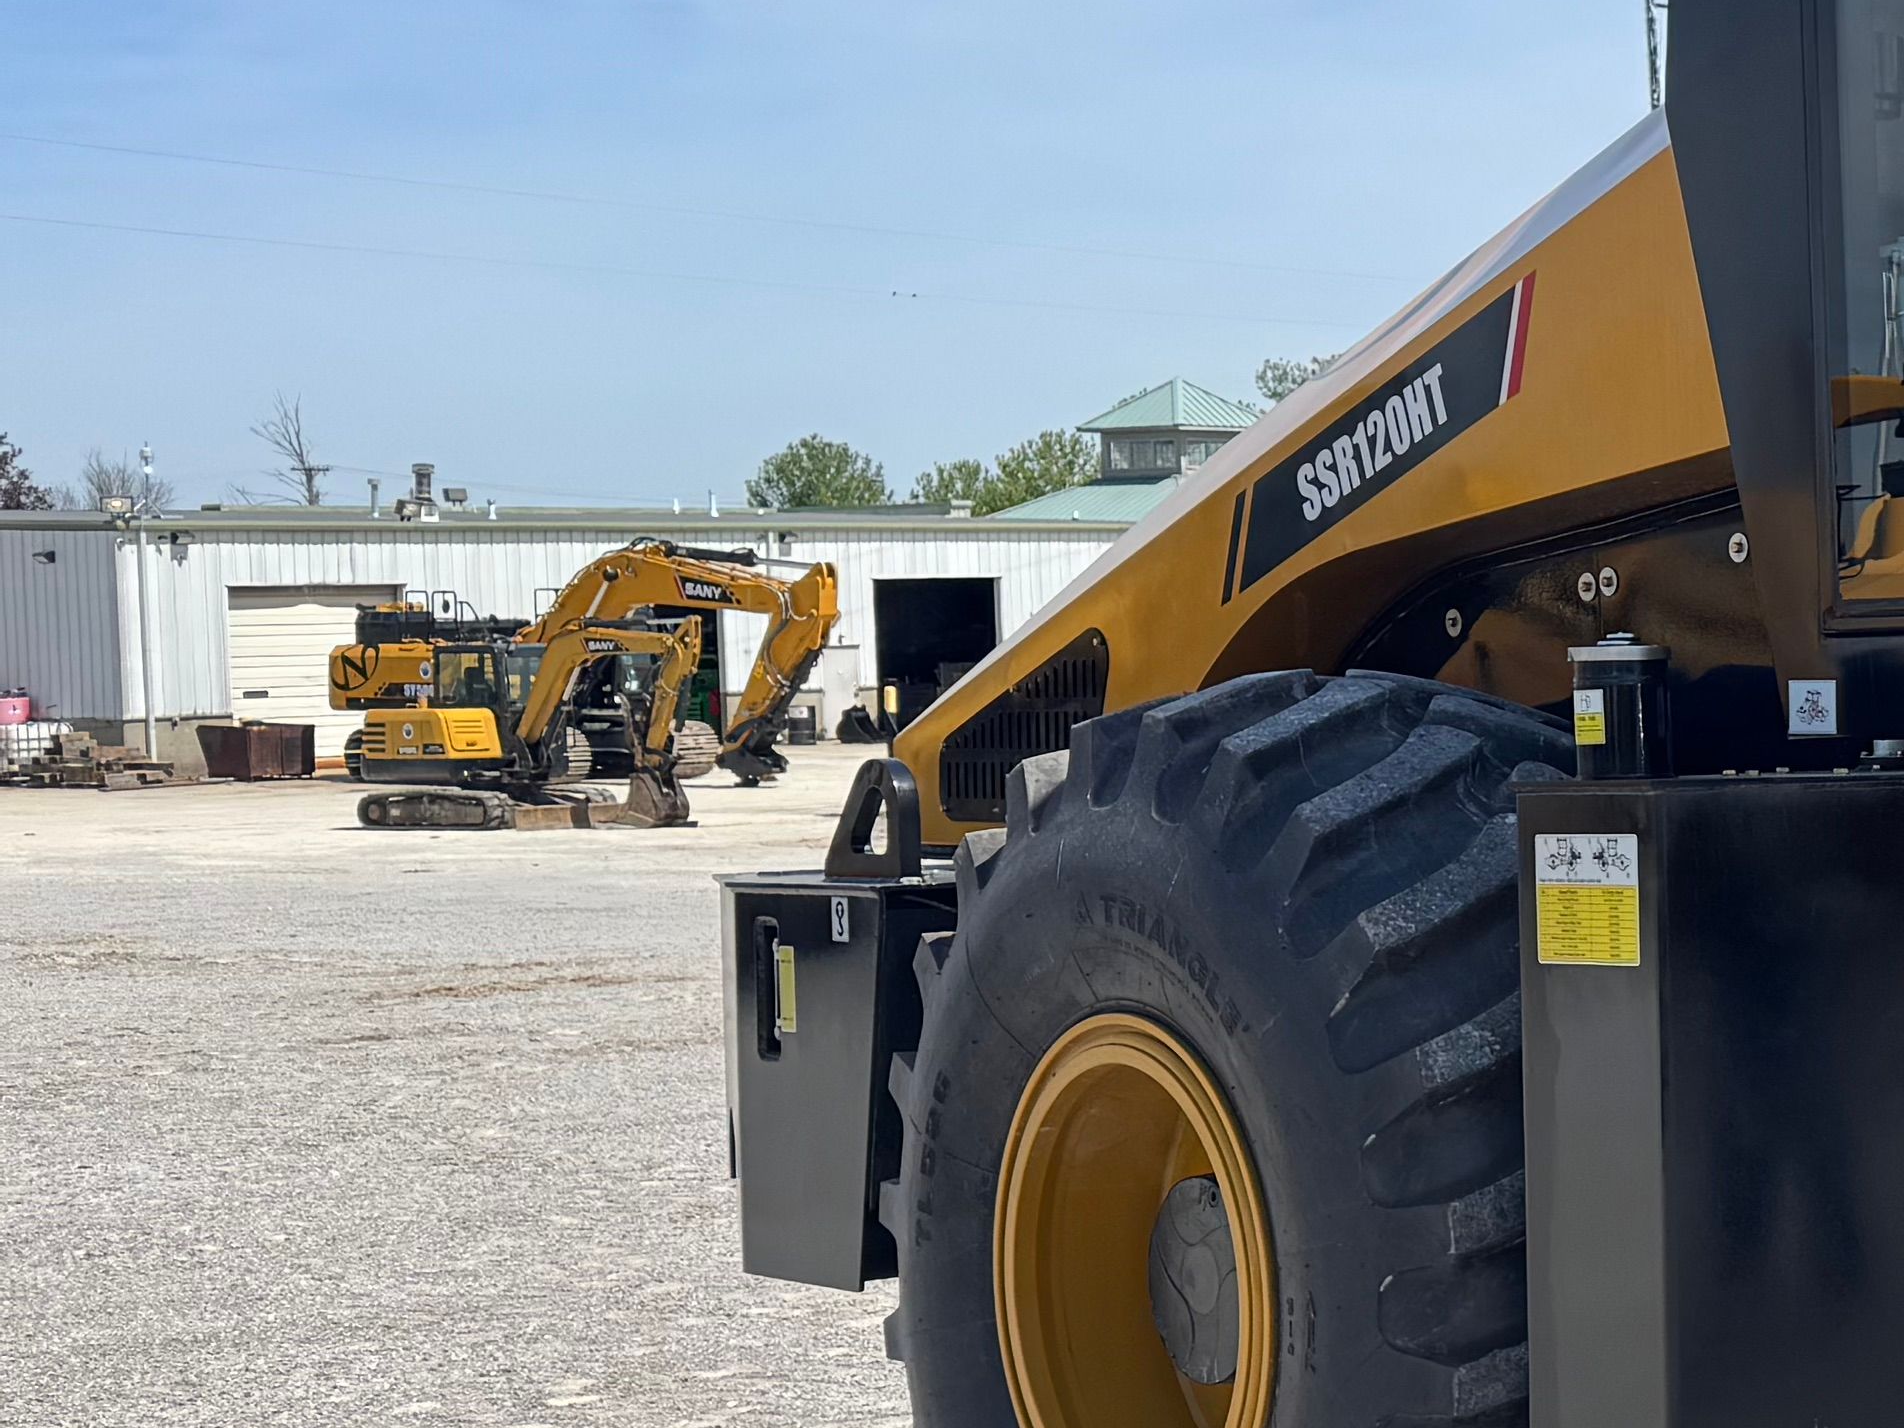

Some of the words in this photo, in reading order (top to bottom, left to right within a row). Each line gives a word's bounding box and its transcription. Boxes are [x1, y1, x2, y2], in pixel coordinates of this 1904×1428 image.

[1296, 362, 1449, 522] SSR120HT
[684, 581, 723, 600] SANY
[587, 640, 616, 652] SANY
[1099, 895, 1243, 1036] TRIANGLE
